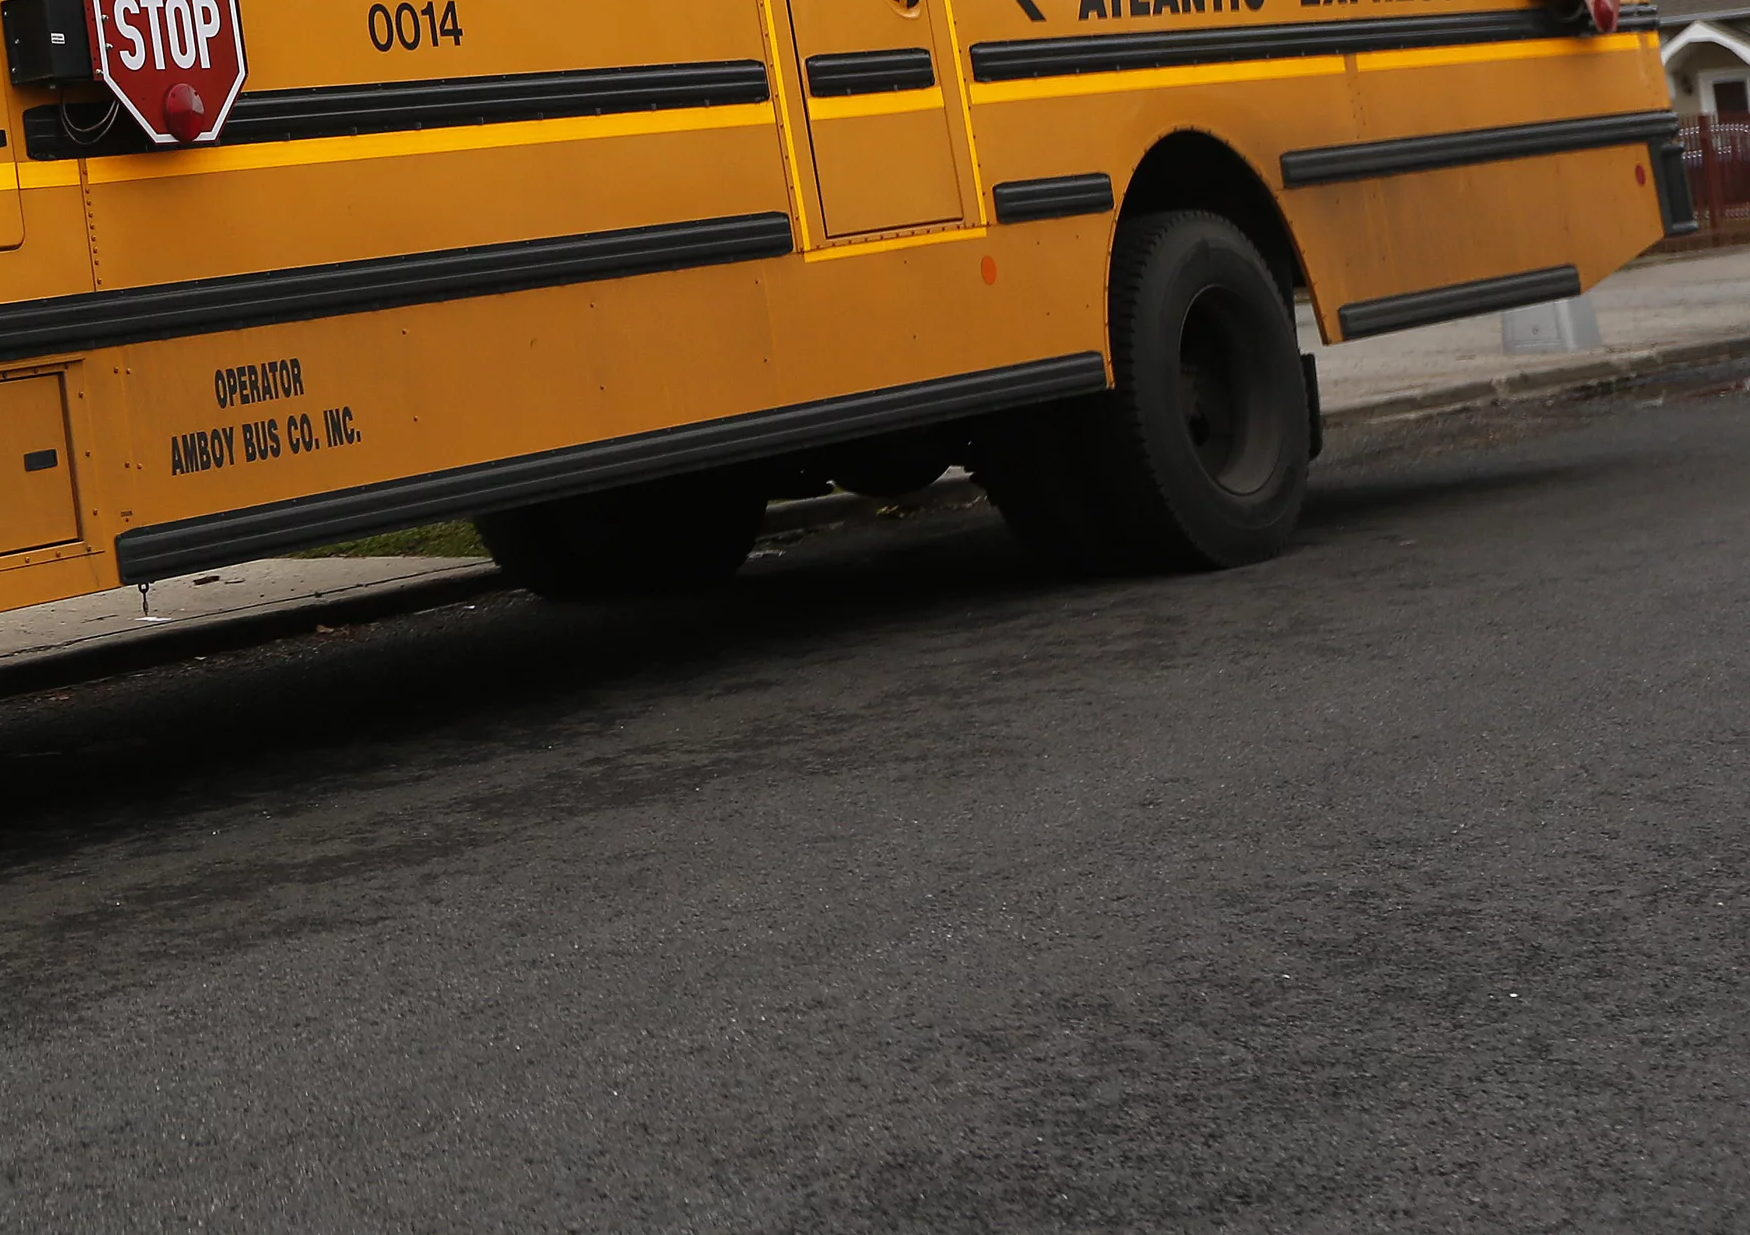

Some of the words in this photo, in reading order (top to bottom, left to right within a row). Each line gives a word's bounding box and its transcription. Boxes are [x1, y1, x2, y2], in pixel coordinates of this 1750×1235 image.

[367, 0, 464, 53] 0014
[214, 358, 305, 409] OPERATOR
[171, 426, 235, 476] AMBOY
[242, 418, 281, 463] BUS
[286, 413, 320, 454] CO.
[323, 405, 362, 448] INC.
